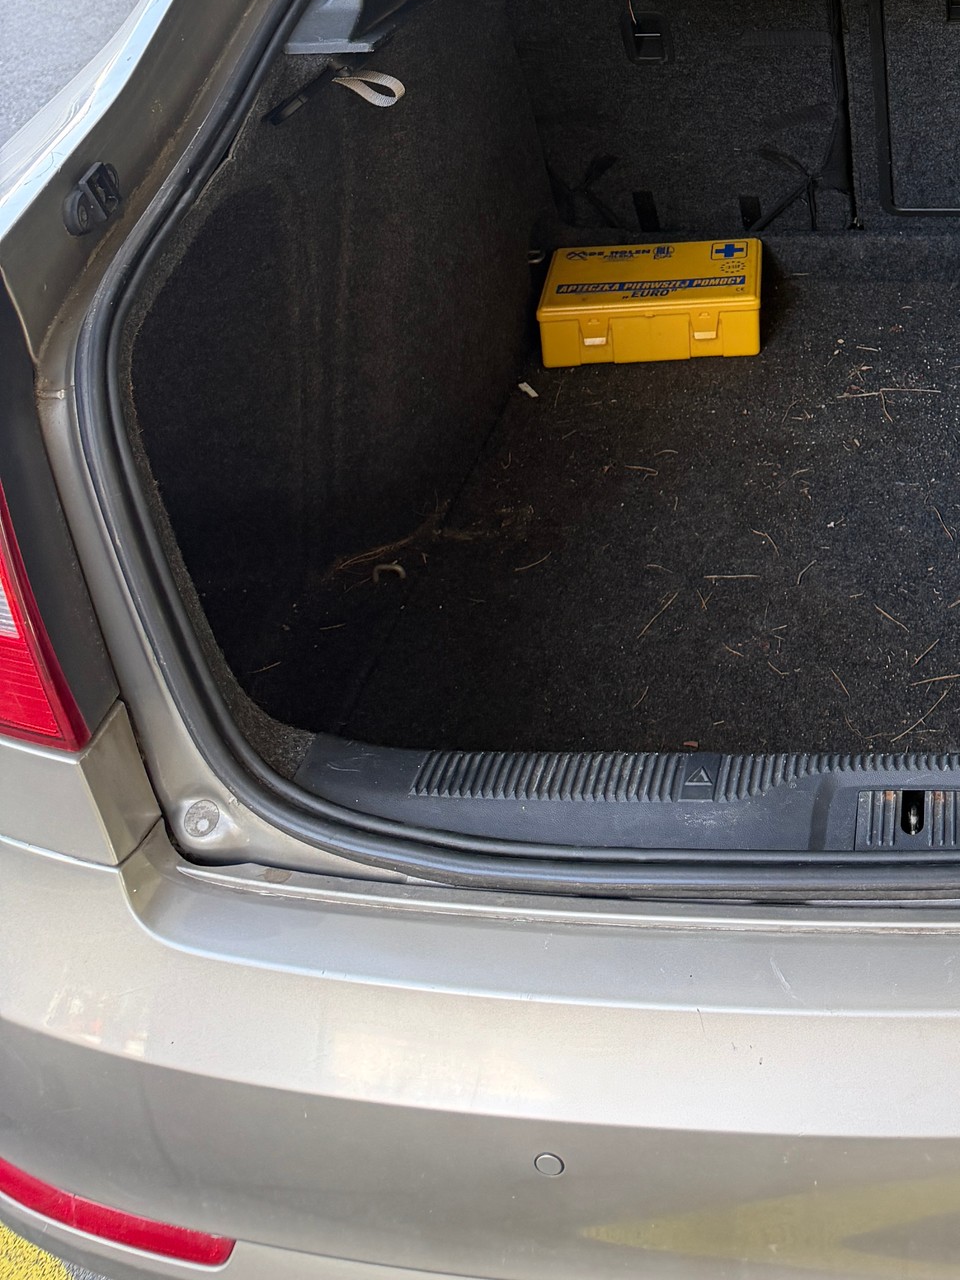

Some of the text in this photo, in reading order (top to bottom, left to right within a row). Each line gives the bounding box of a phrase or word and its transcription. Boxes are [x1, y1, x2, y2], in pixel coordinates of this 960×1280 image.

[558, 276, 745, 294] APTECZKA PIERWSZEJ POMOCY
